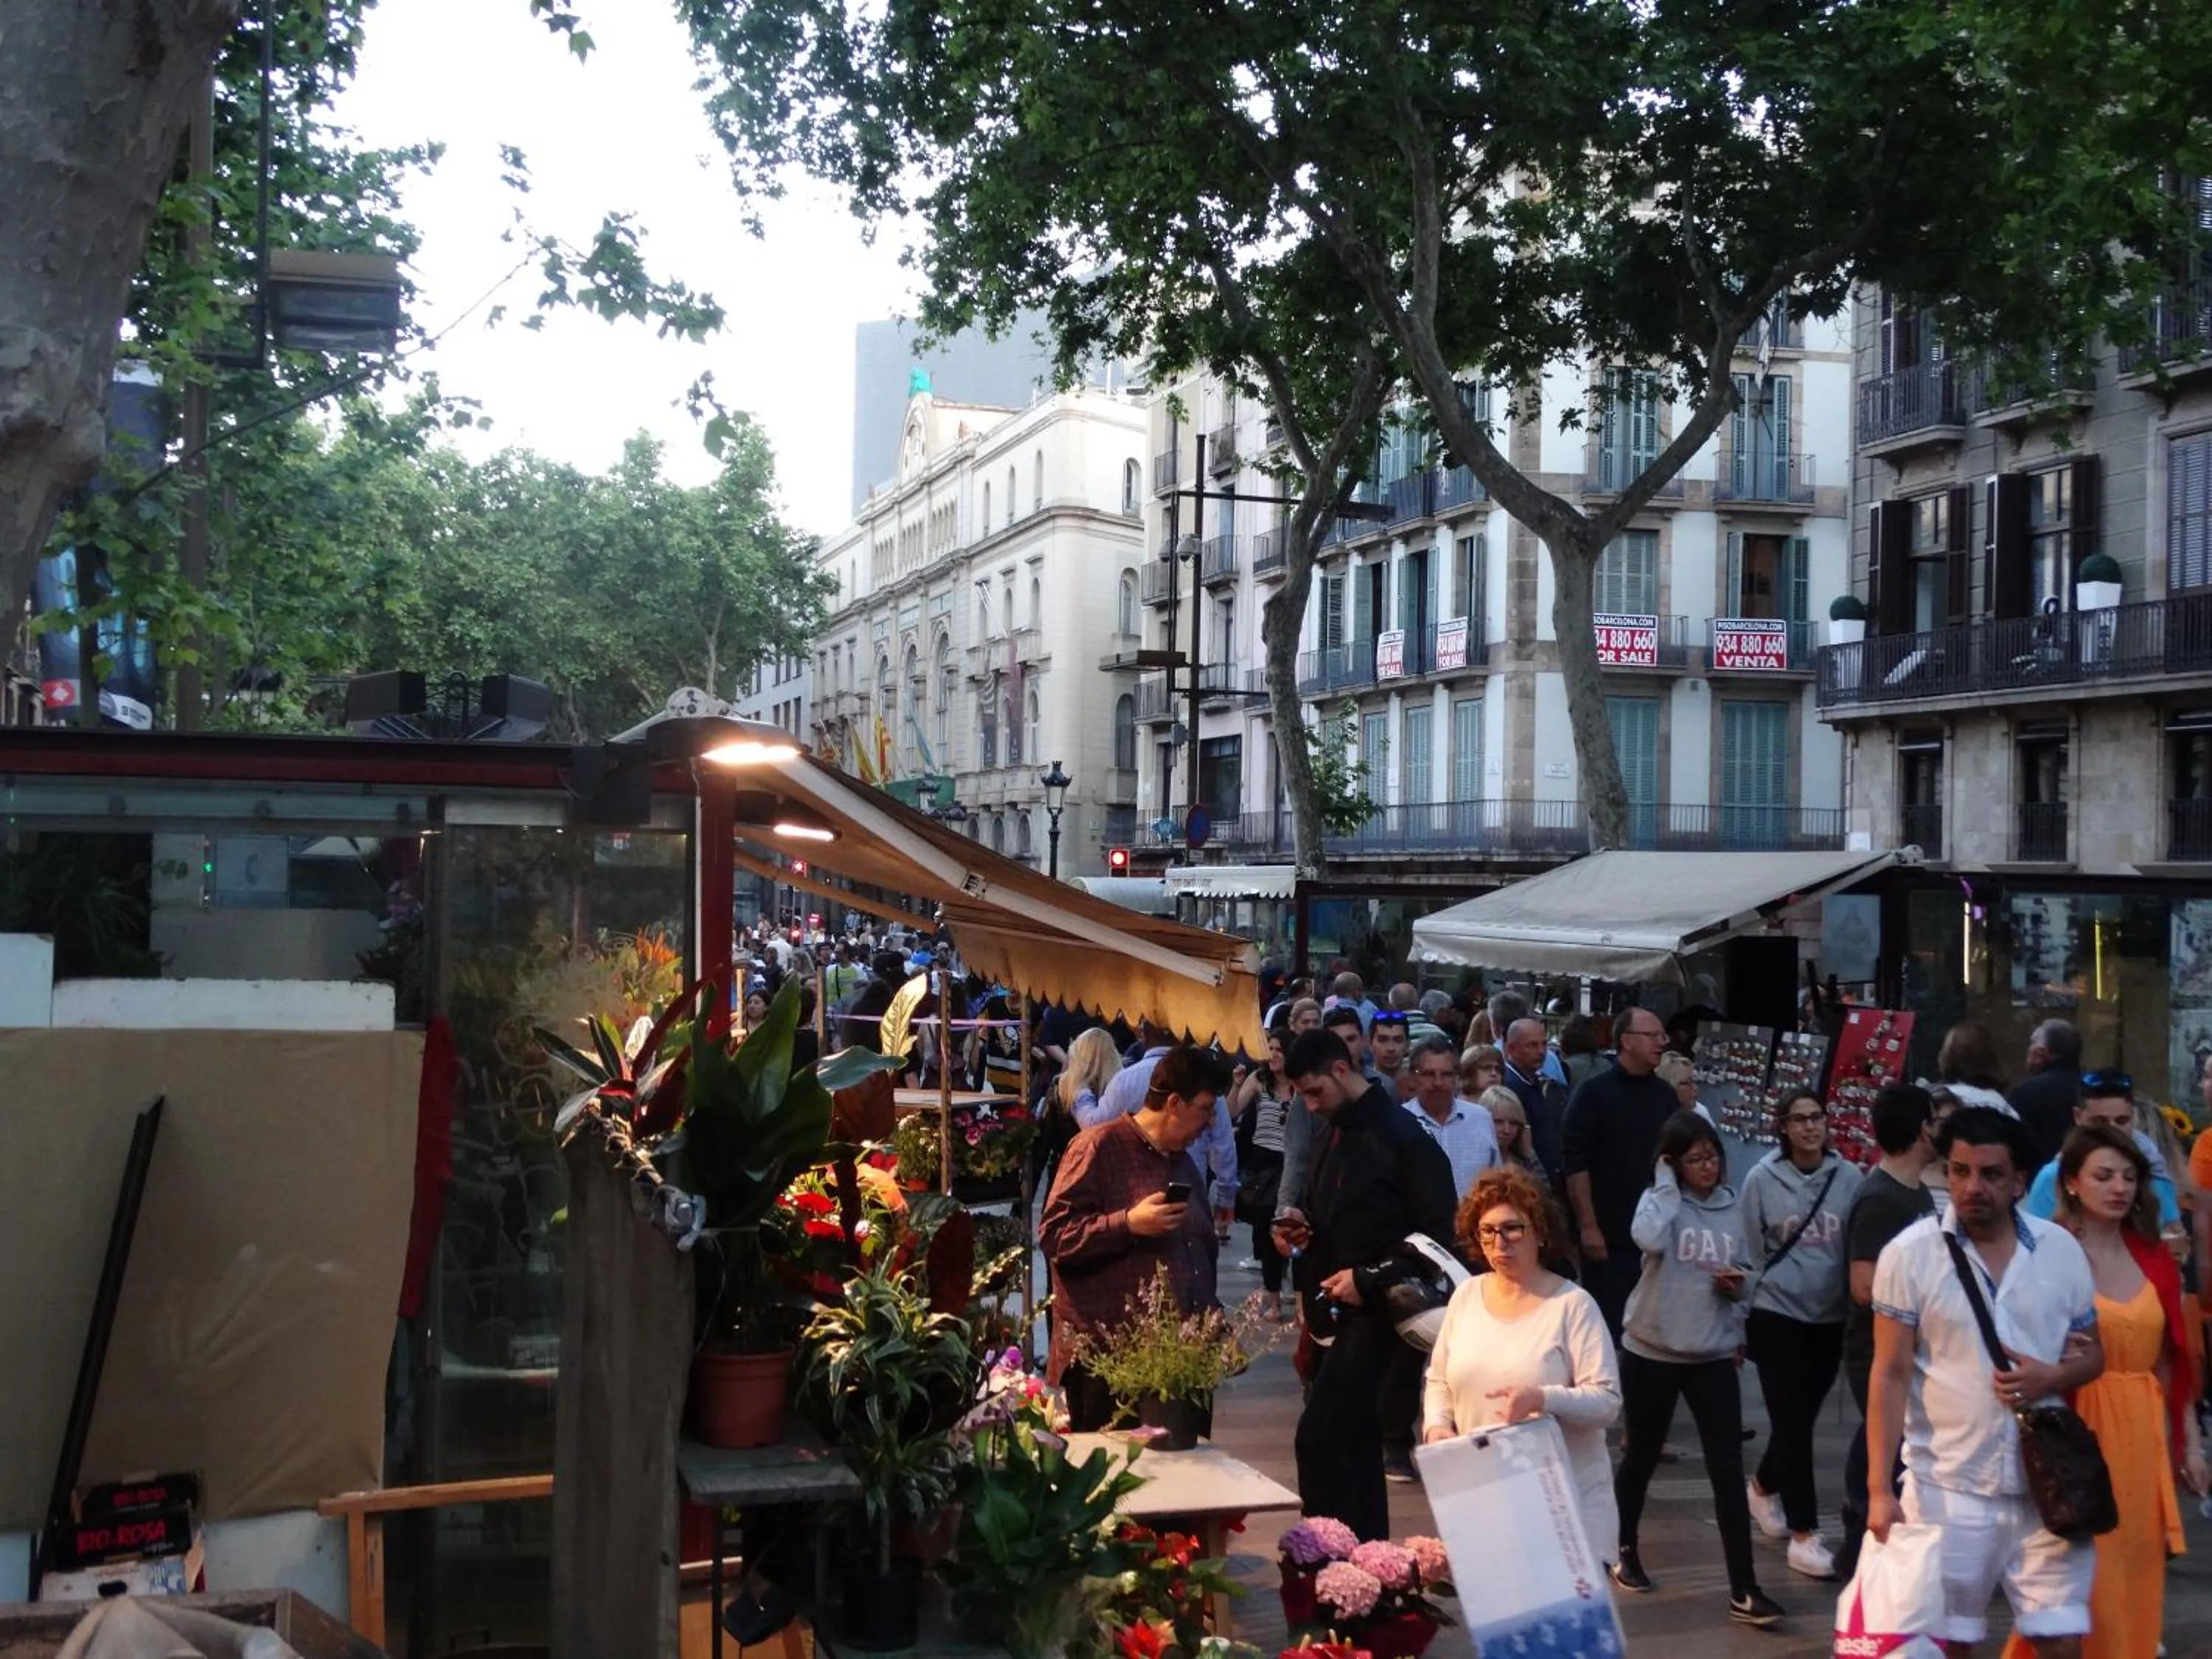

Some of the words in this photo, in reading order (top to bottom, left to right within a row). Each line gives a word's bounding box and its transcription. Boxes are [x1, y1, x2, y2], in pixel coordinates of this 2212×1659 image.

[1593, 616, 1654, 627] SOBARCELONA.COM
[1717, 622, 1783, 631] PISOBARCELONA.COM
[1594, 629, 1607, 647] 34
[1610, 630, 1631, 649] 880
[1633, 631, 1655, 650] 660
[1717, 635, 1737, 653] 934
[1741, 635, 1761, 654] 880
[1764, 636, 1784, 655] 660
[1597, 650, 1615, 661] OR
[1620, 650, 1651, 663] SALE
[1722, 655, 1778, 667] VENTA
[1781, 1210, 1840, 1242] GAP
[1677, 1226, 1736, 1265] GAP
